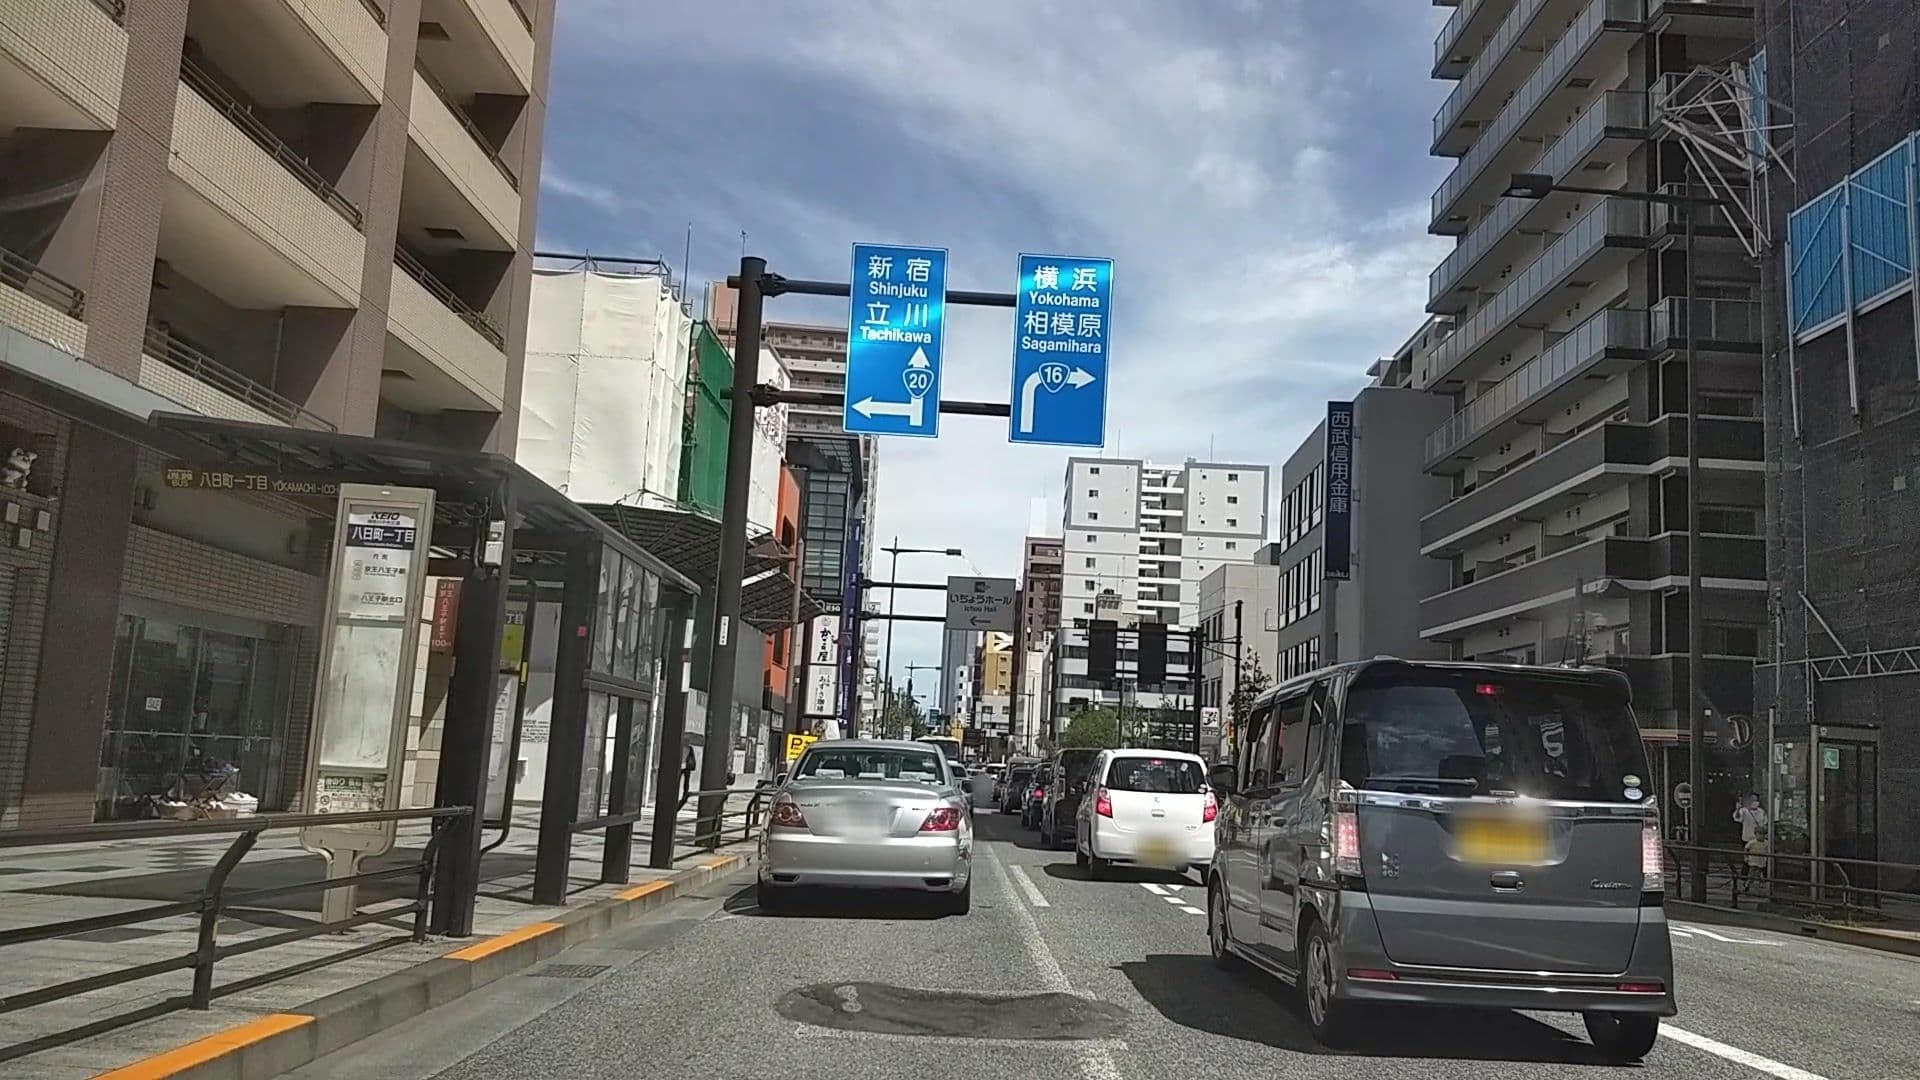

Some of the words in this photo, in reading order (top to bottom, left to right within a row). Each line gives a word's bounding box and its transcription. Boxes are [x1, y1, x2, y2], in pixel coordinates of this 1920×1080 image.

[867, 255, 931, 283] 新宿
[1033, 265, 1097, 292] 横浜
[869, 282, 928, 298] Shinjuku
[1029, 292, 1099, 308] Yokohama
[865, 301, 929, 327] 立川
[1024, 310, 1102, 338] 相模原
[860, 326, 931, 343] Tachikawa
[1021, 336, 1101, 354] Sagamihara
[909, 374, 927, 389] 20
[1044, 366, 1062, 383] 16
[1329, 411, 1350, 514] 西武信用金庫
[200, 472, 268, 490] 八日町一丁目
[371, 511, 400, 520] KEIO
[352, 527, 414, 543] 八日町一丁目
[950, 593, 1012, 606] いちょうホール
[791, 737, 803, 750] P
